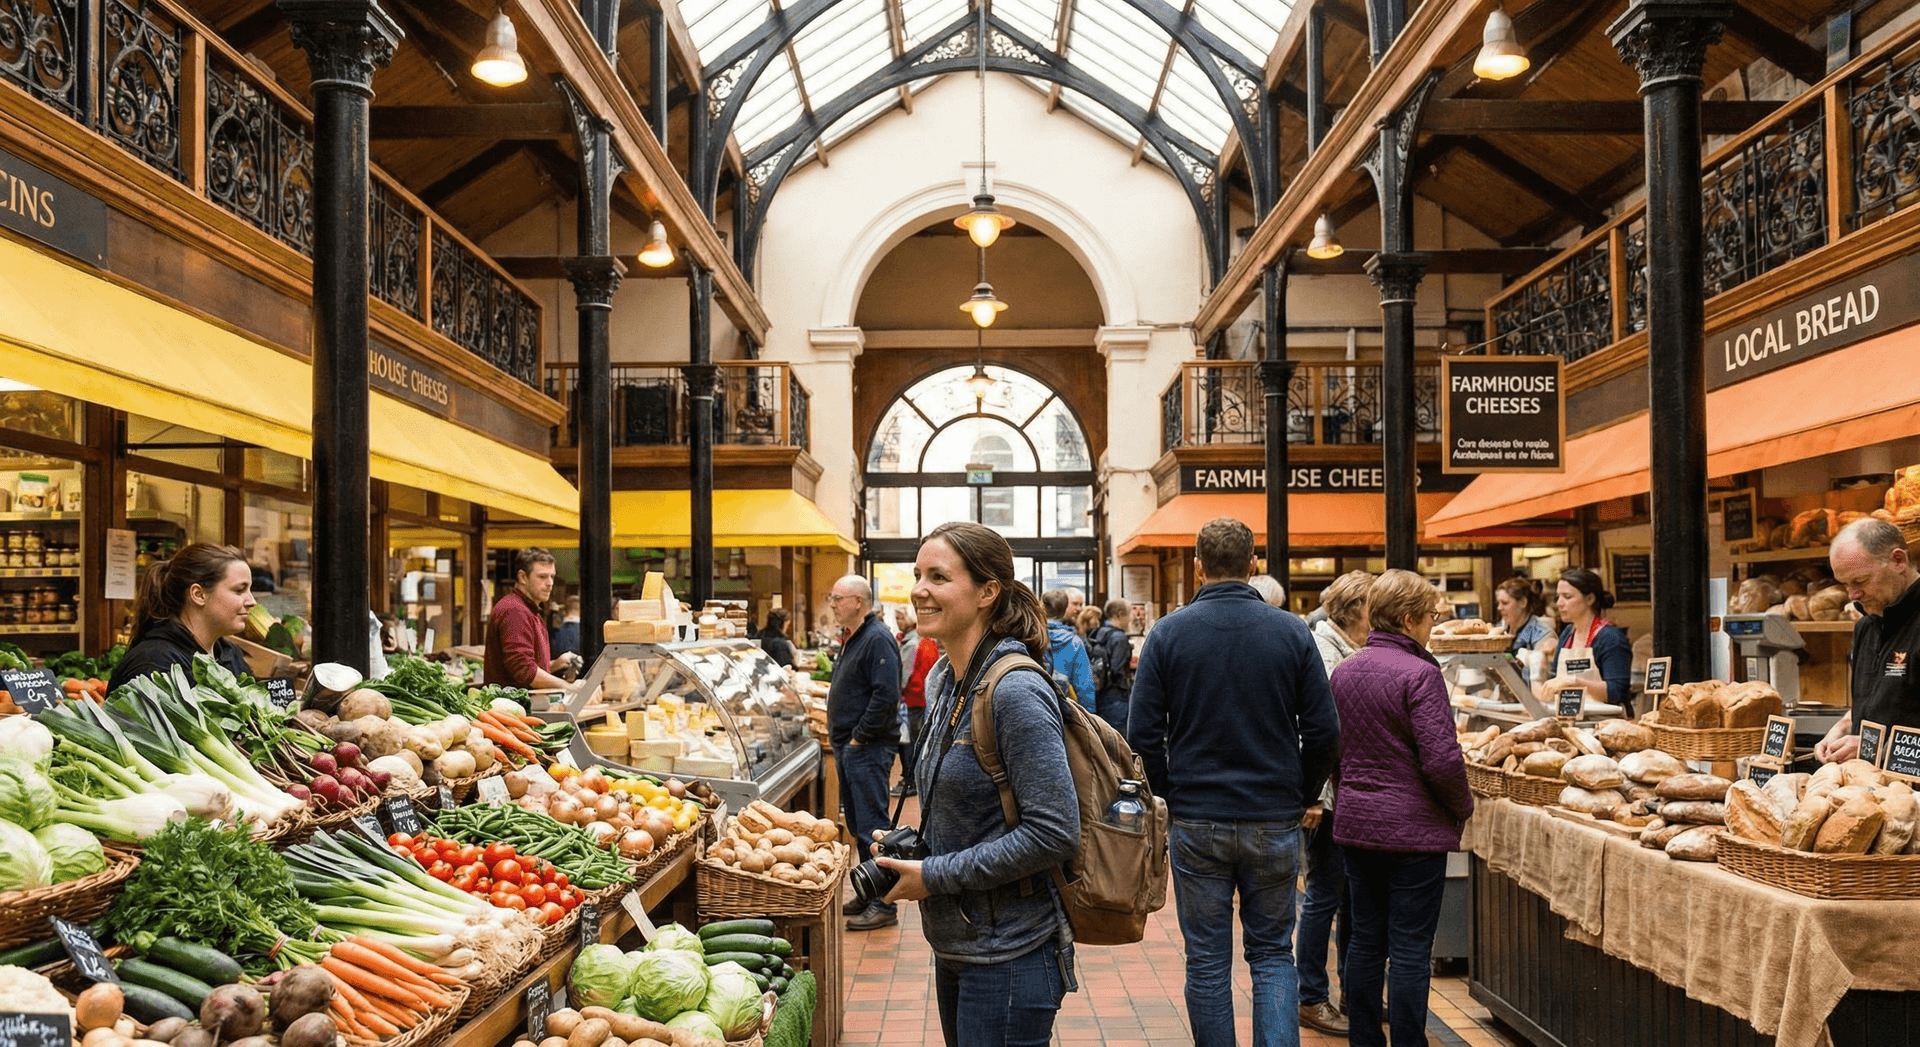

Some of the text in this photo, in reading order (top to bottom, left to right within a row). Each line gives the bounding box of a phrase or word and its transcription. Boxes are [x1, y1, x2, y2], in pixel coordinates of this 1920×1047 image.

[1725, 285, 1880, 372] LOCAL BREAD
[369, 349, 448, 406] HOUSE CHEESES
[1451, 376, 1555, 393] FARMHOUSE
[1465, 397, 1541, 414] CHEESES
[1194, 469, 1322, 488] FARMHUSE
